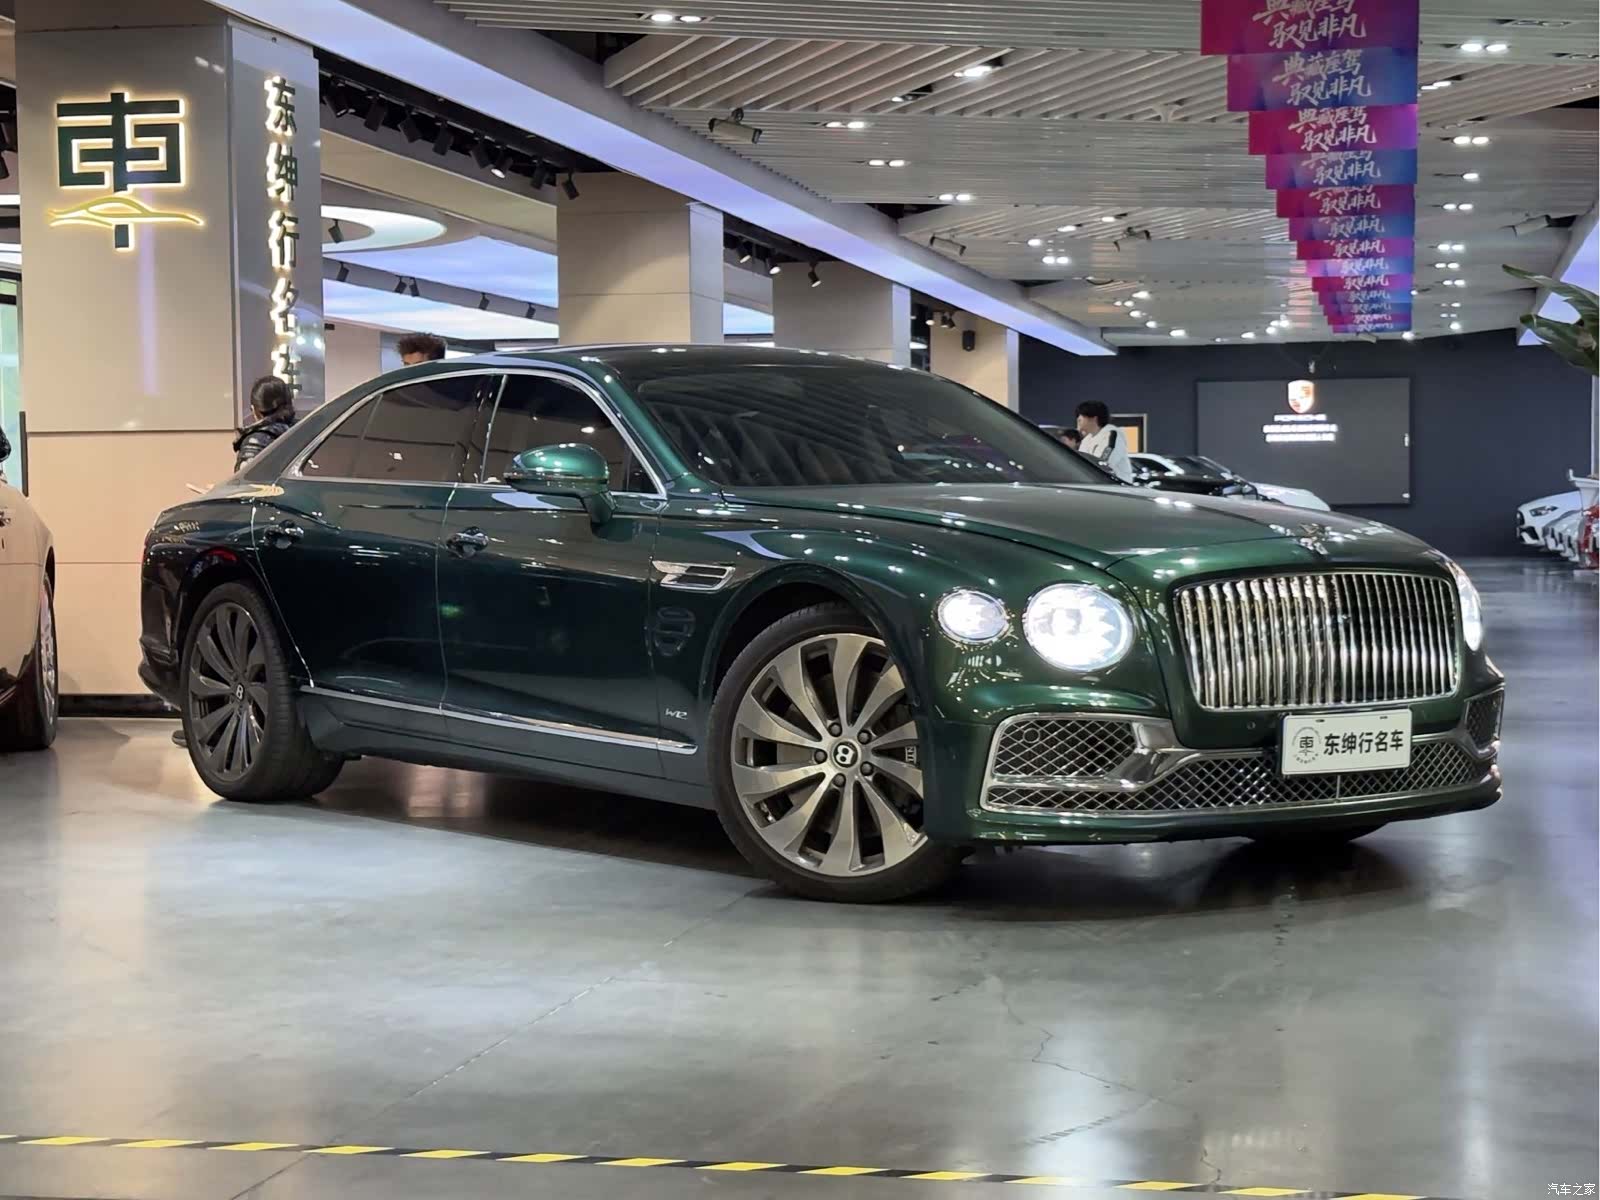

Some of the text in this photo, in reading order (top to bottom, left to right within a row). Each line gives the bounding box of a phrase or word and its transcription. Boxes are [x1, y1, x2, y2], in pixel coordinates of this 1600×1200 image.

[1269, 13, 1366, 49] 驭见非凡
[1287, 75, 1372, 106] 驭见非凡
[1301, 124, 1377, 151] 驭见非凡
[1313, 161, 1382, 185] 驭见非凡
[1323, 729, 1404, 755] 东绅行名车
